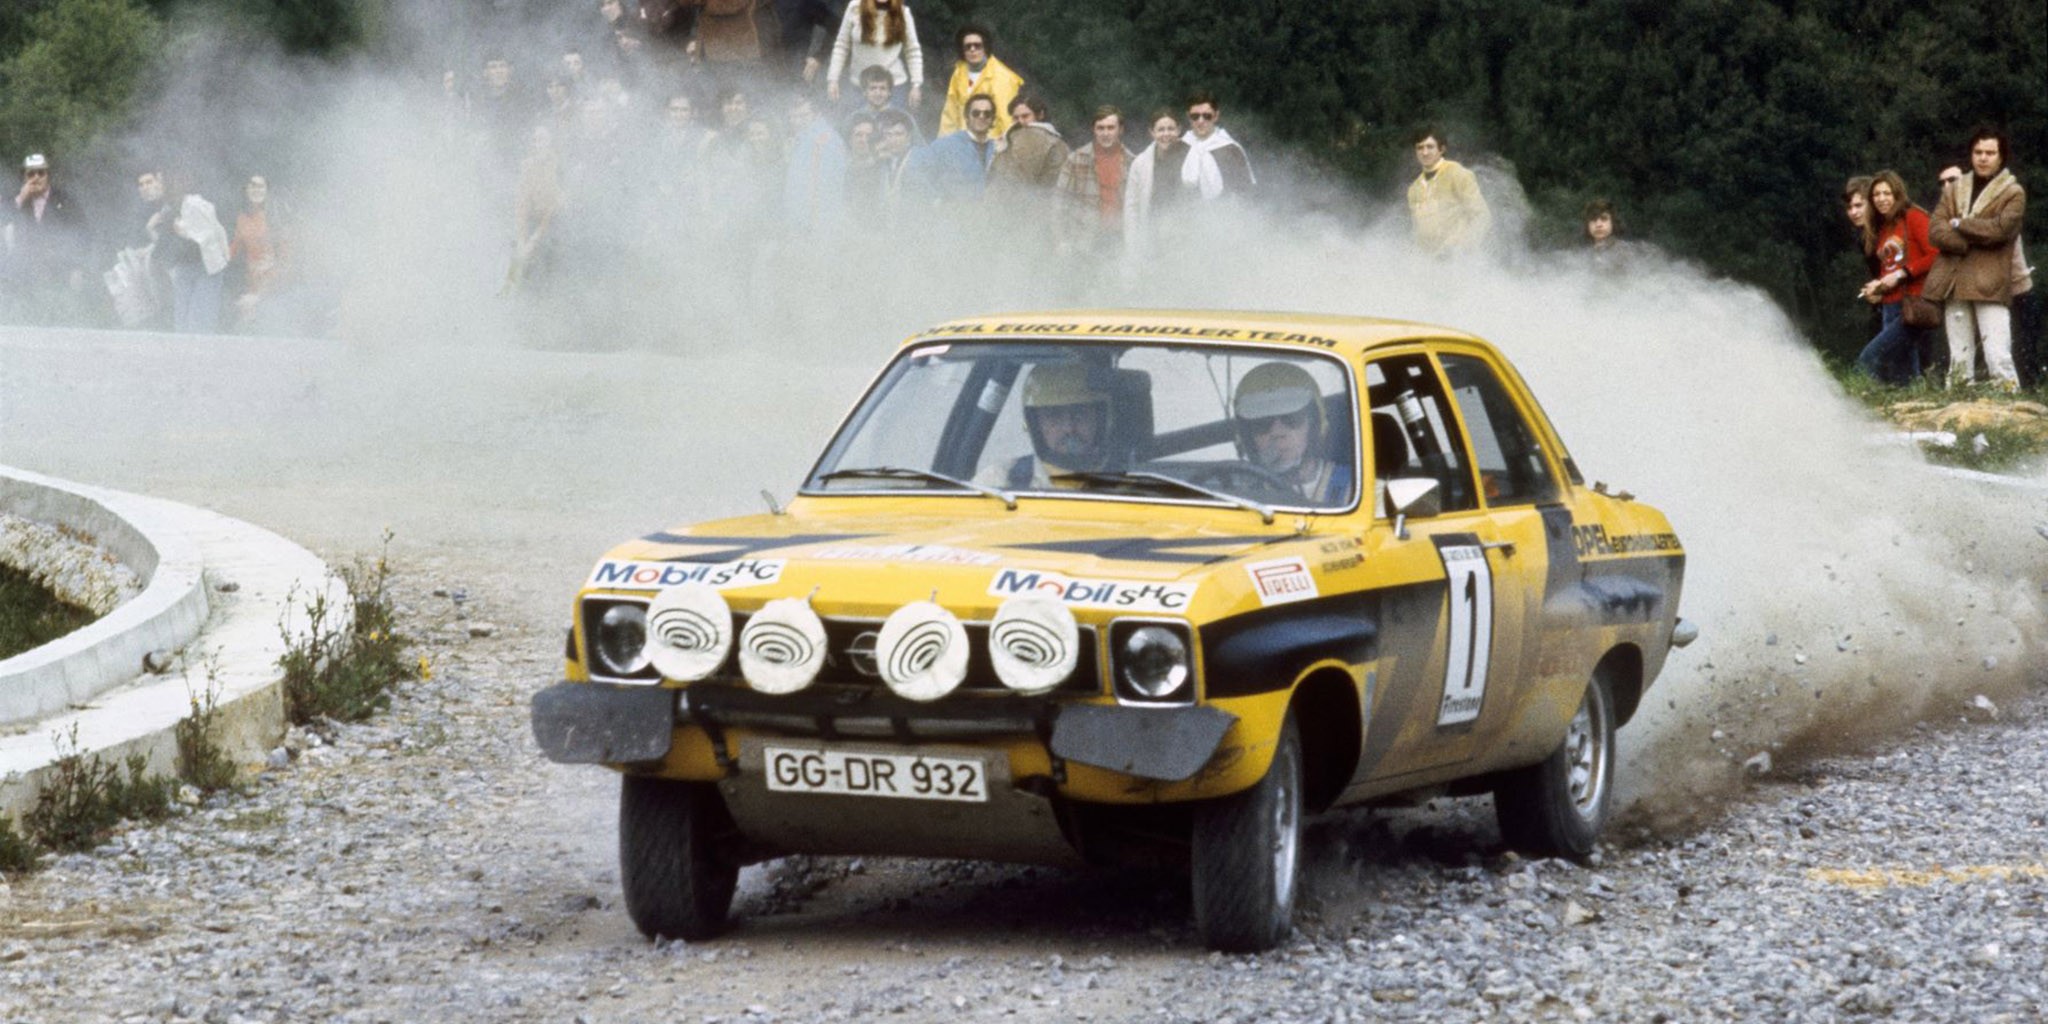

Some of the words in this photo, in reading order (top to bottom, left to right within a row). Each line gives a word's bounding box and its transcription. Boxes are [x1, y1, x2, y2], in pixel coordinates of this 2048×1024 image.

[993, 323, 1079, 333] EURO
[1246, 329, 1337, 348] TEAM
[1571, 524, 1616, 557] OPEL
[595, 561, 713, 586] Mobil
[1253, 563, 1311, 597] PIRELLI
[1463, 570, 1477, 689] 1
[773, 753, 898, 793] GG-DR
[911, 760, 979, 796] 932
